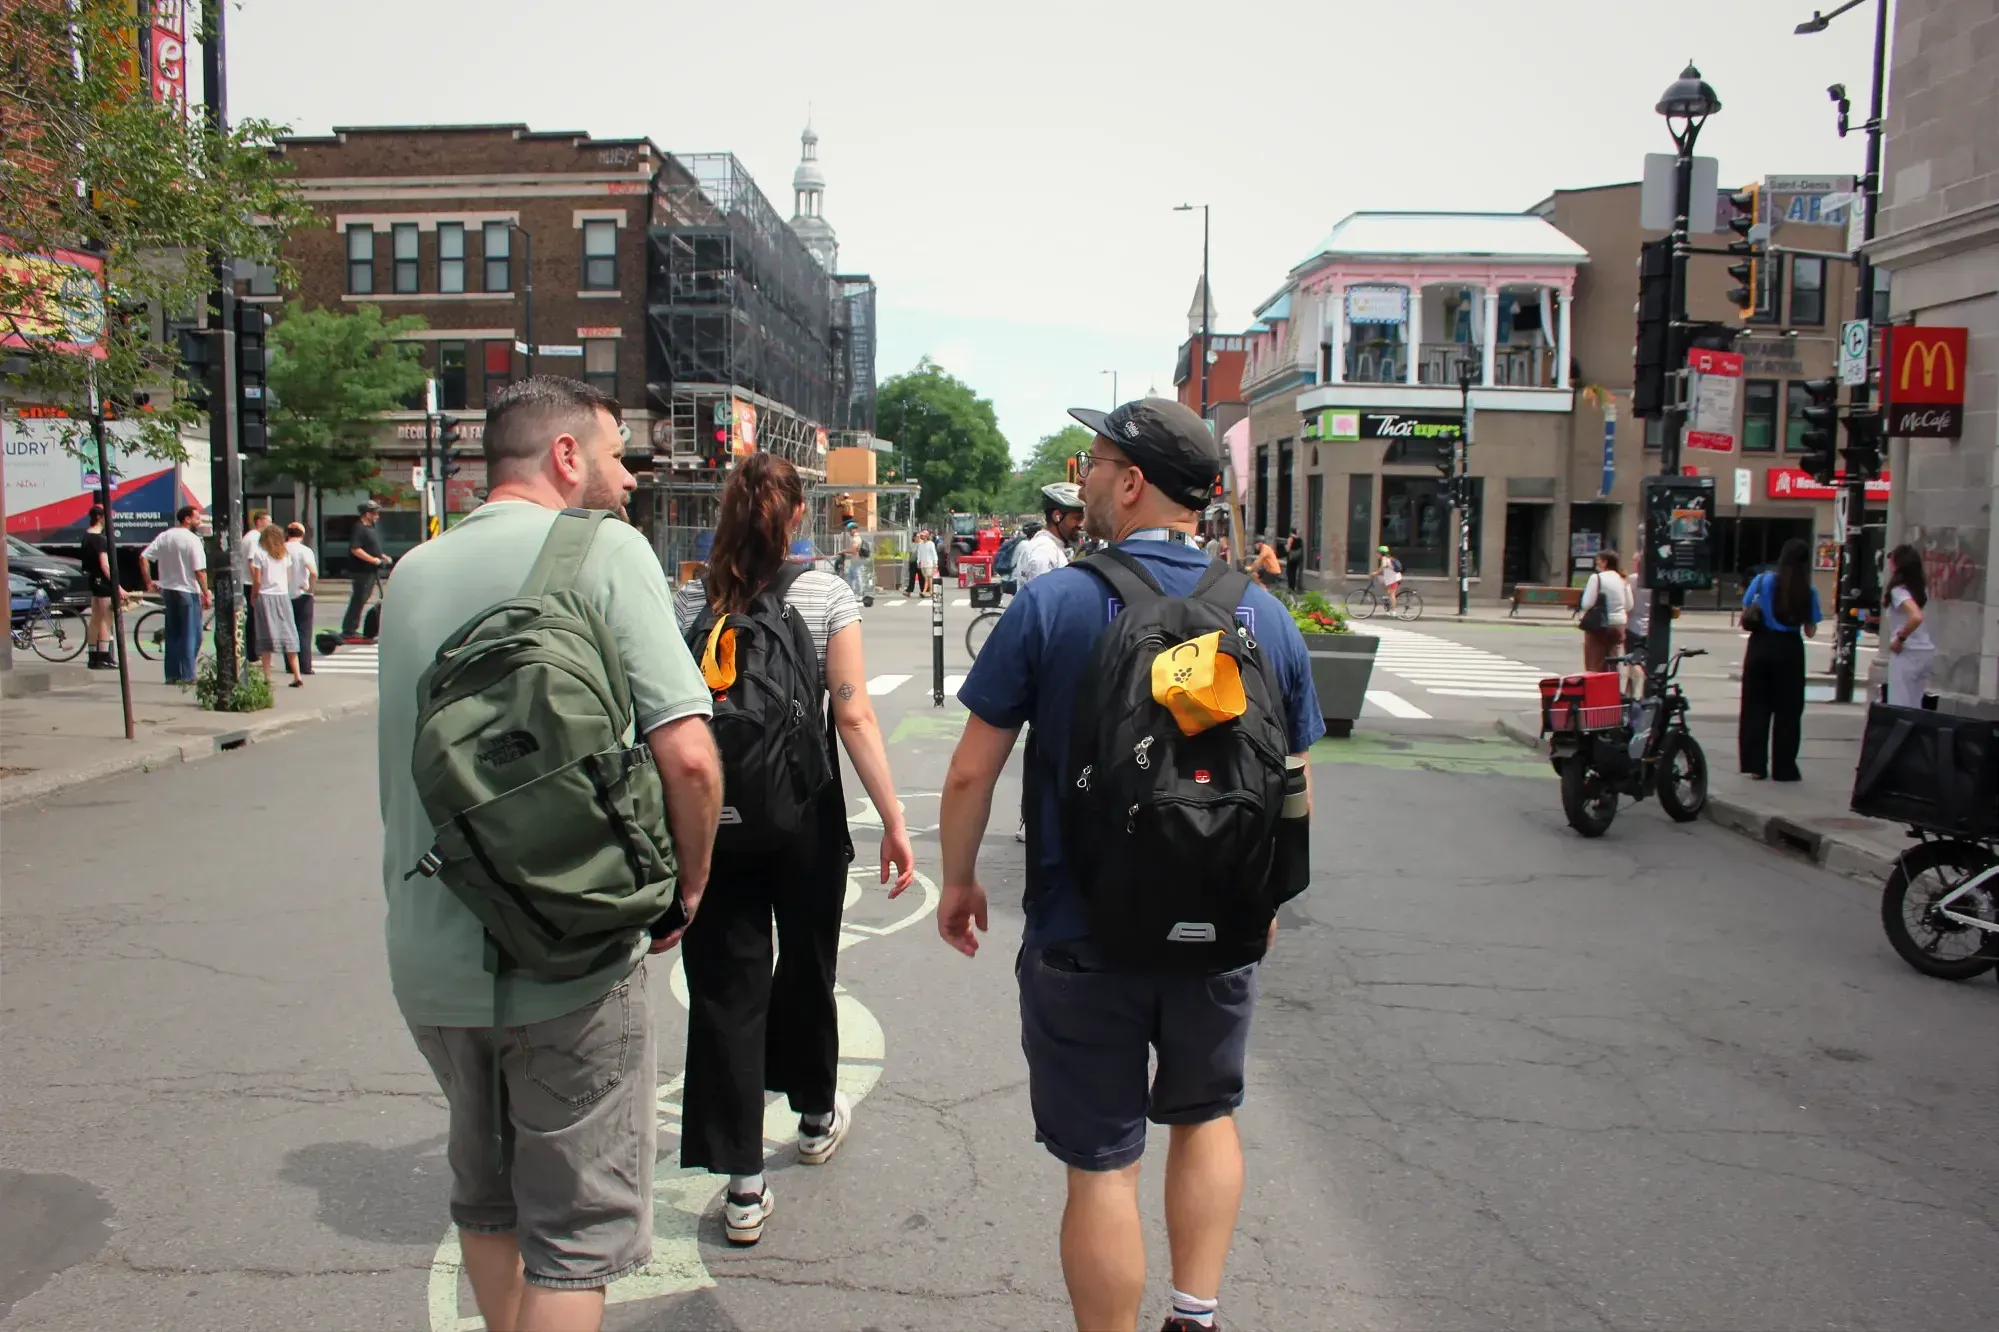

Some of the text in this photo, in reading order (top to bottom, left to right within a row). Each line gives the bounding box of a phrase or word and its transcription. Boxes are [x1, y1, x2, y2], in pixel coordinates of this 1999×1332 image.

[1768, 181, 1831, 190] Saint-Denis
[1368, 414, 1418, 436] Thaï
[1900, 410, 1952, 432] McCafé
[3, 441, 49, 456] UDRY
[136, 511, 161, 519] NOUS!
